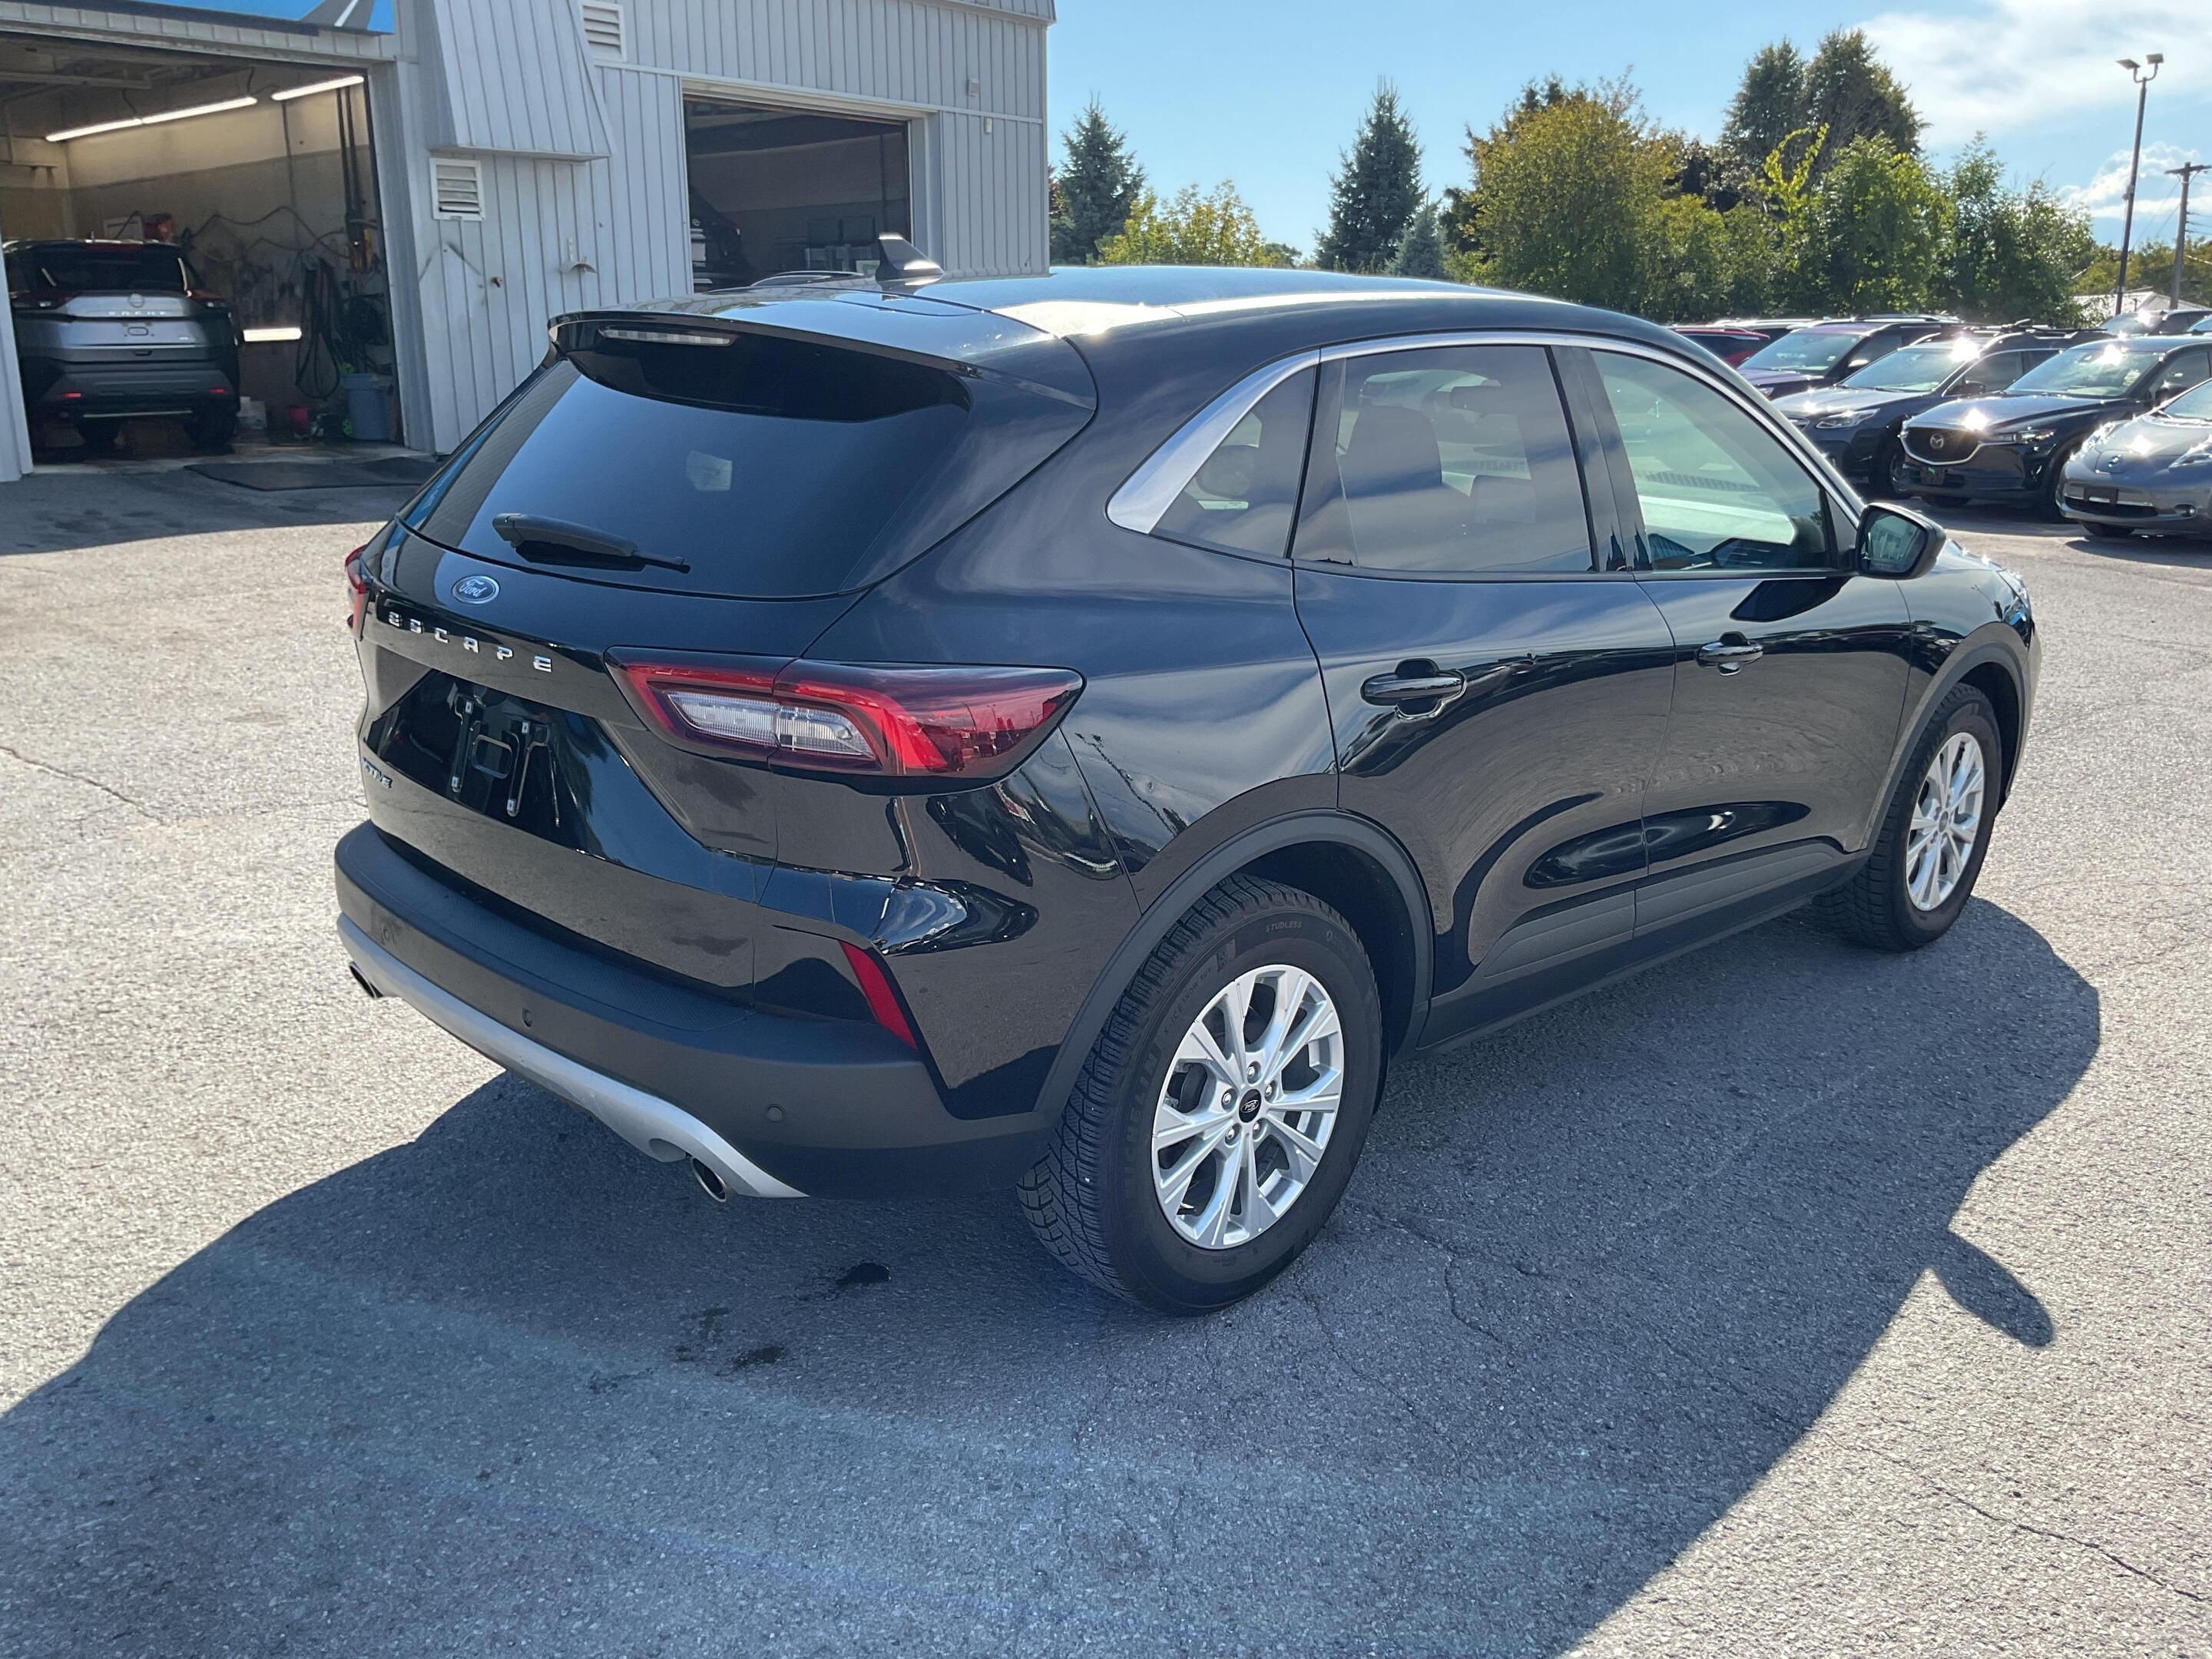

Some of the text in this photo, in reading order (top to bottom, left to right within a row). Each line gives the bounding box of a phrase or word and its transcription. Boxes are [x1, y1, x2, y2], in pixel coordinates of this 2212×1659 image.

[459, 578, 488, 598] Ford
[388, 611, 553, 673] ESCAPE
[1265, 921, 1303, 932] STUDLESS
